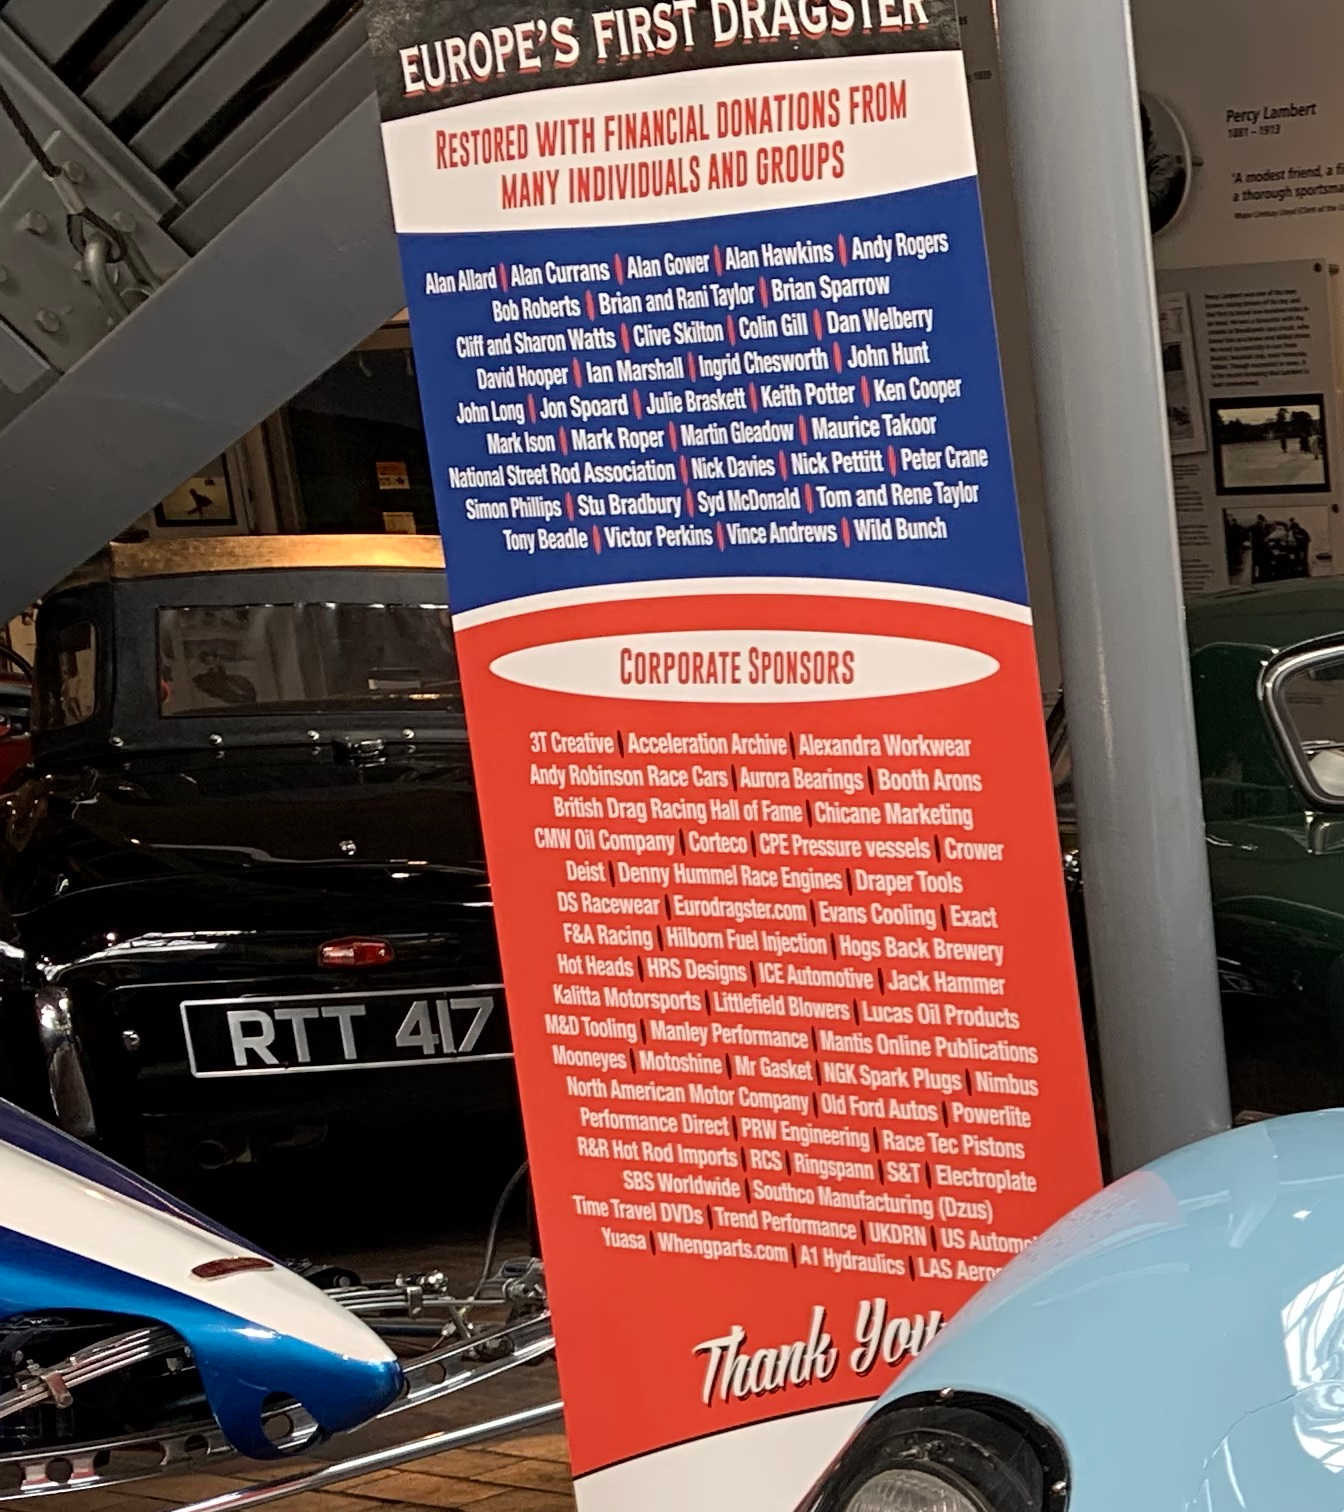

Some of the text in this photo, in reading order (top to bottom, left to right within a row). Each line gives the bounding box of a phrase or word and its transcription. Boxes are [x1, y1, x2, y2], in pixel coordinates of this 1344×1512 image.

[399, 16, 580, 93] EUROPE'S
[593, 0, 698, 60] FIRST
[436, 80, 907, 170] RESTORED WITH FINANCIAL DONATIONS FROM
[1226, 103, 1317, 124] Percy Lambert
[501, 142, 845, 210] MANY INDIVIDUALS AND GROUPS
[1242, 186, 1292, 201] thorough
[1246, 168, 1285, 183] modest
[425, 233, 949, 295] Alan Allard Alan Currans Alan Gower Alan Hawkins Andy Rogers
[449, 445, 988, 489] National Street Rod Association Nick Davies Nick Pettitt Peter Crane
[503, 516, 947, 554] Tony Beadle Victor Perkins Vince Andrews Wild Bunch
[620, 646, 855, 686] CORPORATE SPONSORS
[530, 731, 971, 757] 3T Creative Acceleration Archive Alexandra Workwear
[557, 892, 998, 930] DS Racewear Eurodragster.com Evans Cooling Exact
[227, 997, 494, 1066] RTT 417
[552, 1045, 1038, 1096] Mooneyes Motoshine Mr Gasket NGK Spark Plugs Nimbus
[693, 1305, 836, 1404] Thank
